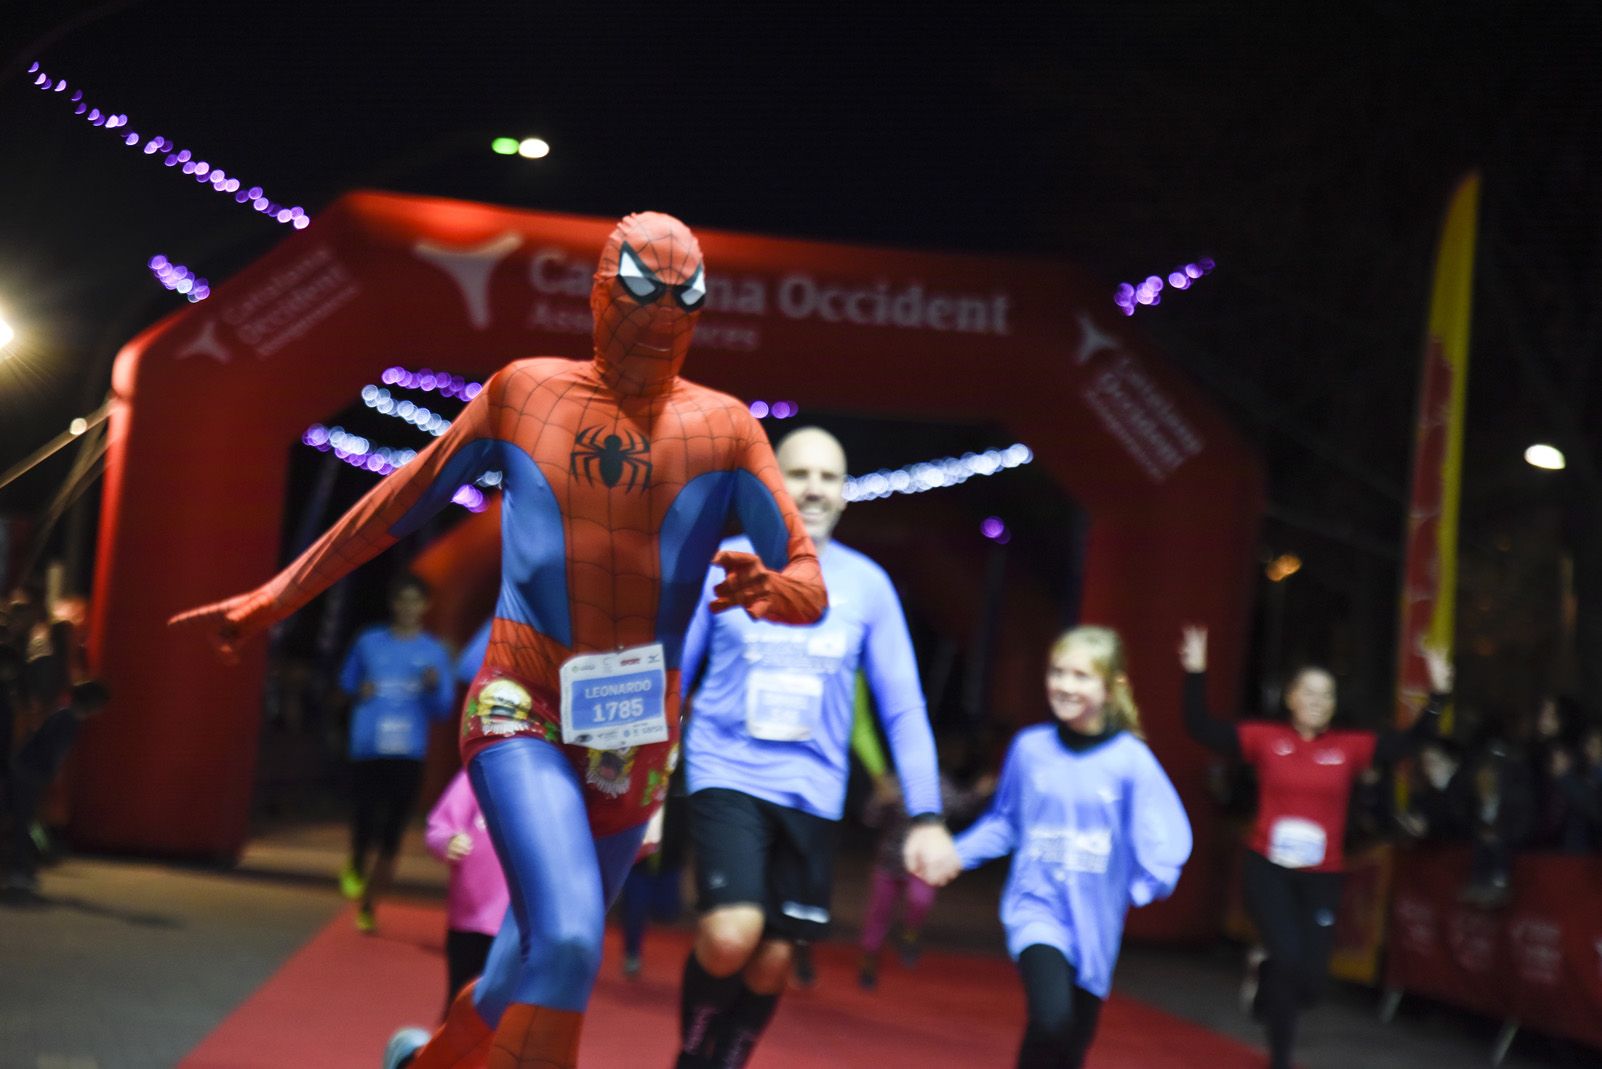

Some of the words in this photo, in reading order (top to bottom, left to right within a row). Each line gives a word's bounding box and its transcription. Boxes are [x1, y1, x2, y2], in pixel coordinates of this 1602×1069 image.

[779, 274, 1011, 335] Occident
[584, 679, 652, 699] LEONARDO
[592, 697, 645, 723] 1785
